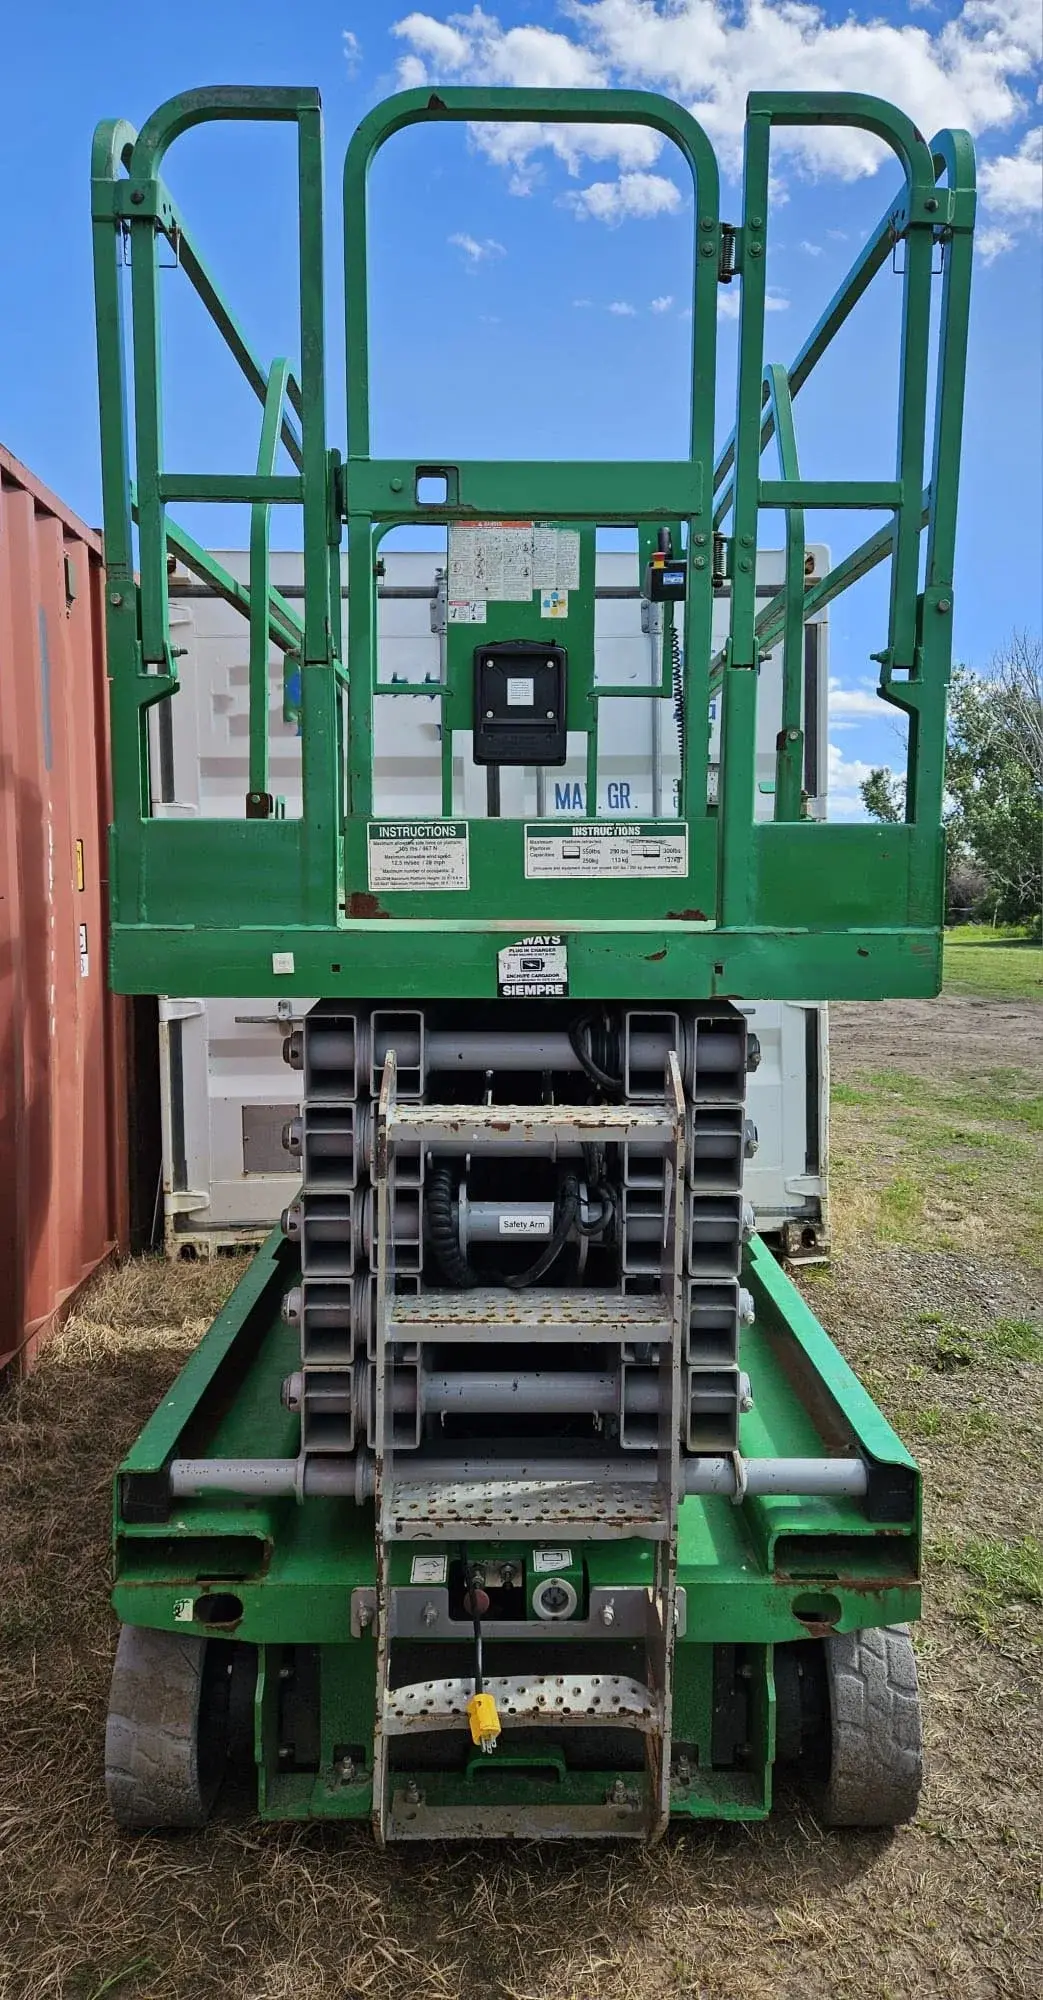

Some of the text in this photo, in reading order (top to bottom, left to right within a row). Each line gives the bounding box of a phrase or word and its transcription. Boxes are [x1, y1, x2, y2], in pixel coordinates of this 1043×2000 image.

[555, 782, 639, 810] MA. GR.
[379, 825, 456, 837] INSTRUCTIONS
[572, 826, 641, 836] INSTRUCTIONS
[514, 935, 561, 946] WAYS
[502, 984, 564, 996] SIEMPRE
[503, 1220, 545, 1230] Safety Arm
